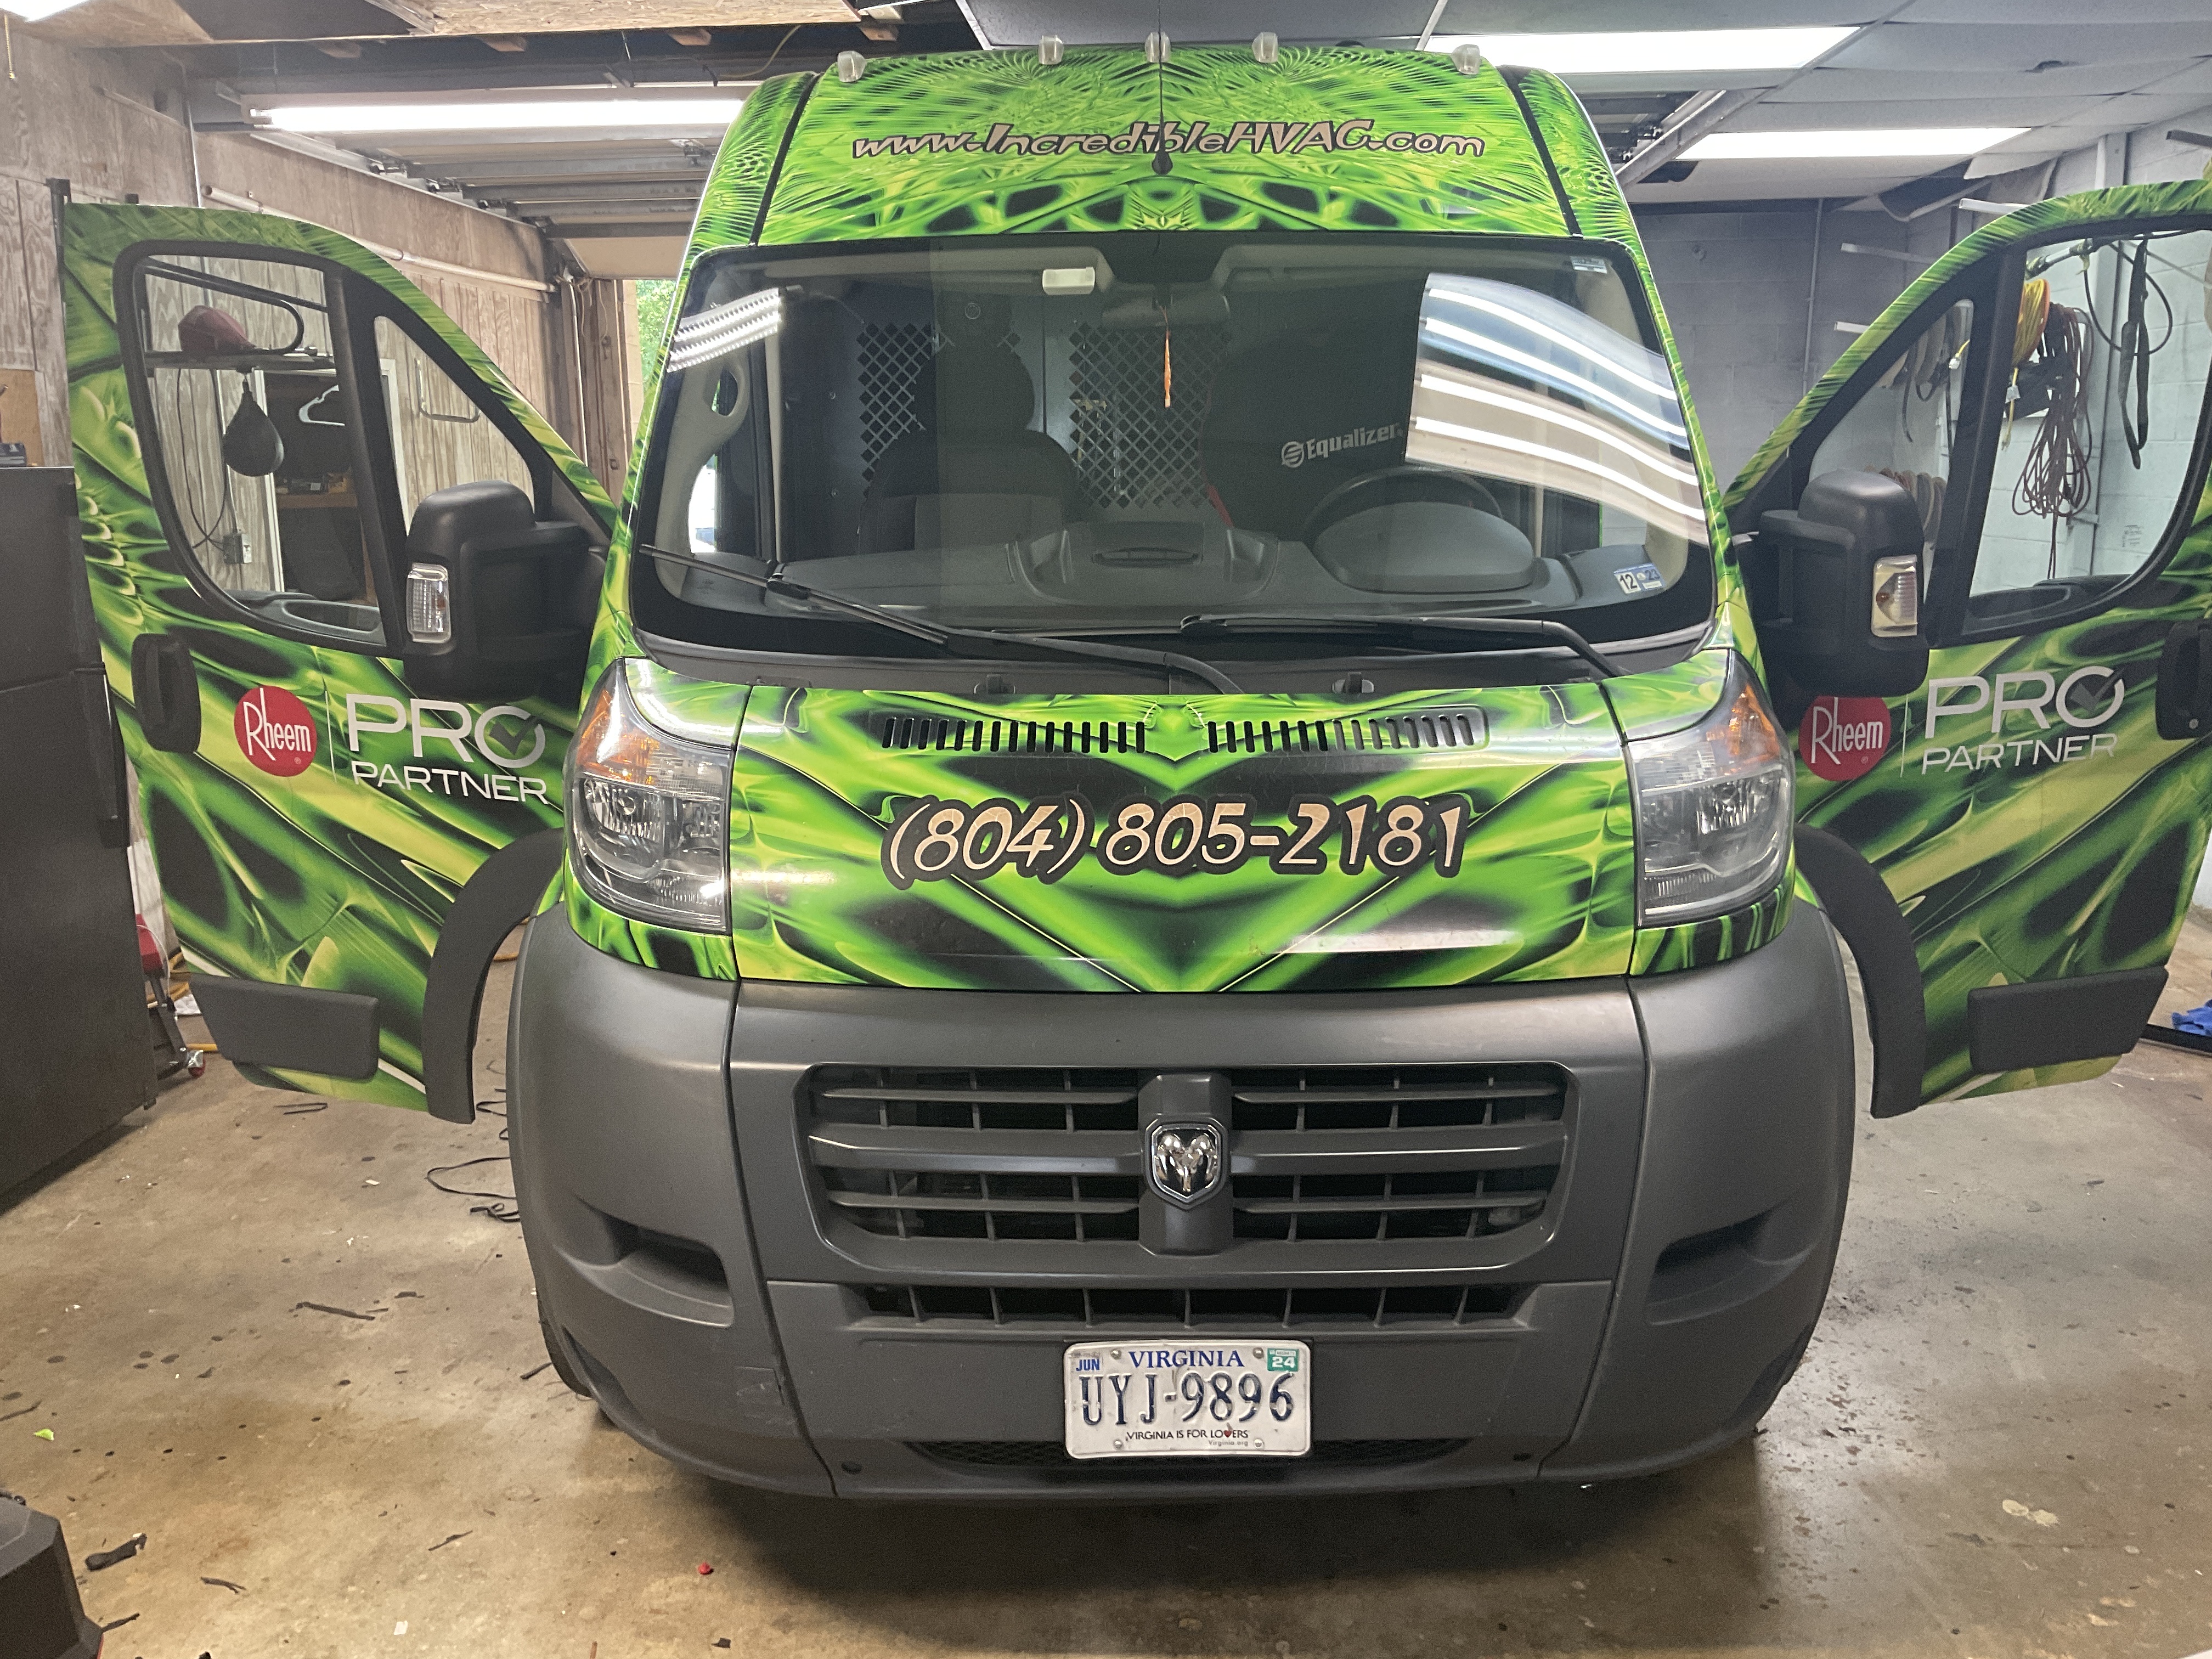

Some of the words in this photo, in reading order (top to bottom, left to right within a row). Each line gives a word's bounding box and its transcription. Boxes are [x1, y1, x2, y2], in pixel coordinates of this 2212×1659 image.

[853, 120, 1485, 158] www.IncredibleHVAC.com
[1307, 423, 1400, 460] Equalizer
[1620, 574, 1637, 590] 12
[1645, 569, 1660, 580] 23
[243, 687, 311, 761] Rheem
[1925, 665, 2125, 738] PRO
[346, 693, 545, 768] PRO
[1811, 697, 1883, 764] Rheem
[1921, 733, 2118, 775] PARTNER
[351, 760, 548, 805] PARTNER
[886, 796, 1089, 883] (804)
[1102, 799, 1464, 871] 805-2181
[1076, 1358, 1100, 1371] JUN
[1128, 1350, 1245, 1368] VIRGINIA
[1272, 1356, 1295, 1368] 24
[1079, 1372, 1294, 1425] UYJ-9896
[1127, 1431, 1174, 1440] VIRGINIA
[1176, 1430, 1184, 1438] IS
[1187, 1429, 1207, 1438] FOR
